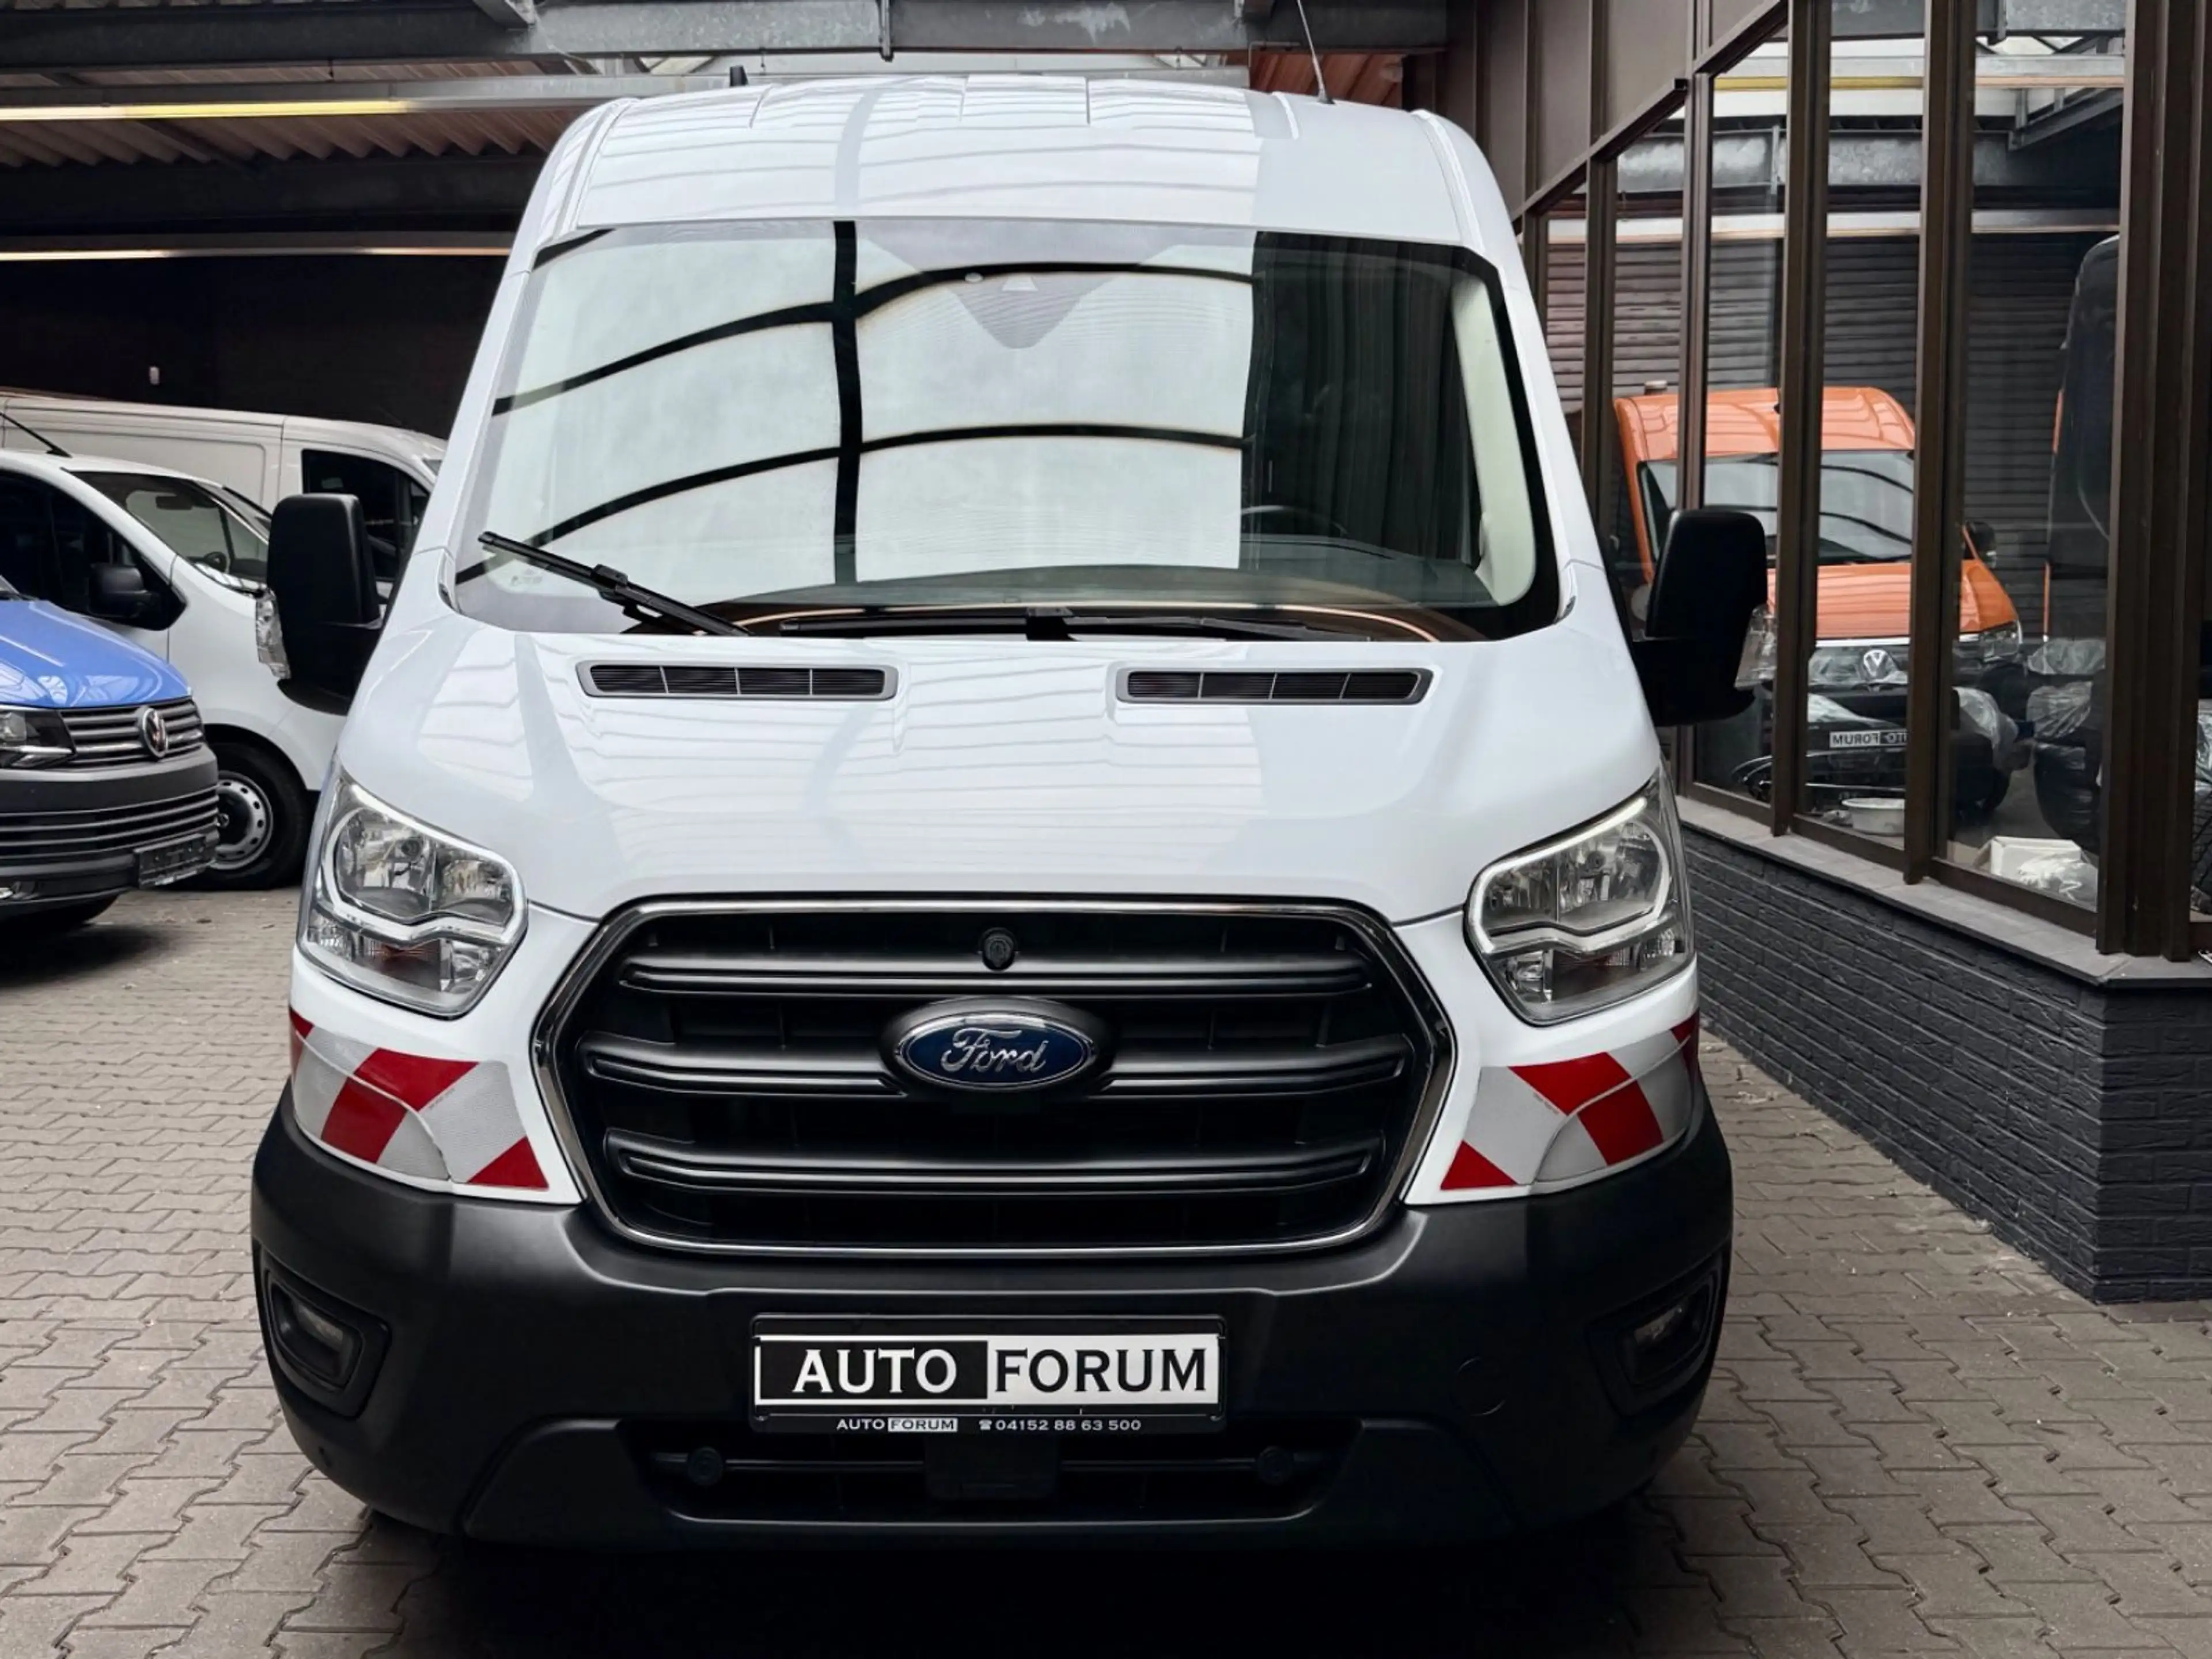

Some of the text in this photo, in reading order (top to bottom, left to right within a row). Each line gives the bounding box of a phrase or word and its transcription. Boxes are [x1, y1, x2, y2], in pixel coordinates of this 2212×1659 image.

[941, 1027, 1049, 1072] Ford
[791, 1347, 1207, 1394] AUTO FORUM
[836, 1418, 1142, 1431] AUTO FORUM 04152 88 63 500
